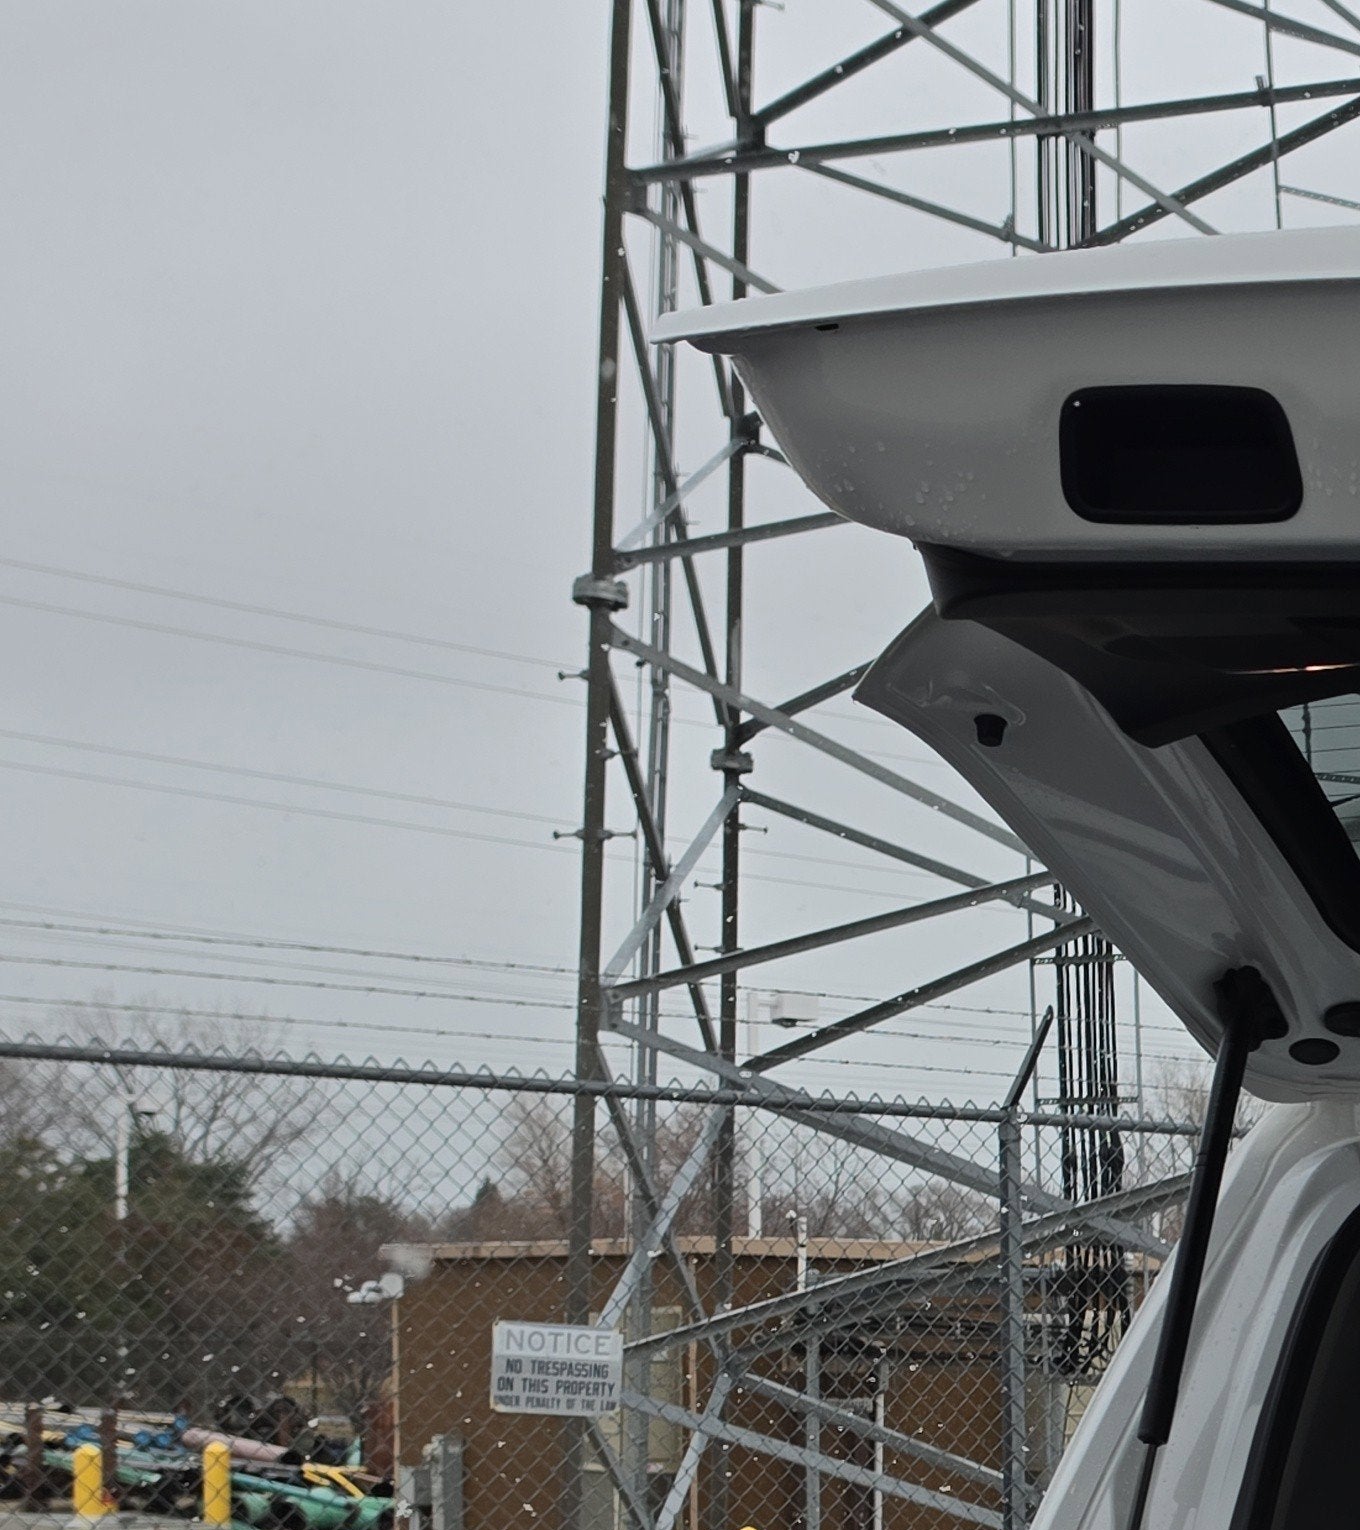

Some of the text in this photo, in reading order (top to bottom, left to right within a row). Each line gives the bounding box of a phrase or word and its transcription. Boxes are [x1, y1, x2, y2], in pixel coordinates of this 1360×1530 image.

[506, 1329, 611, 1356] NOTICE
[505, 1358, 609, 1379] NO TRESPASSING
[497, 1376, 615, 1397] ON THIS PROPERTY
